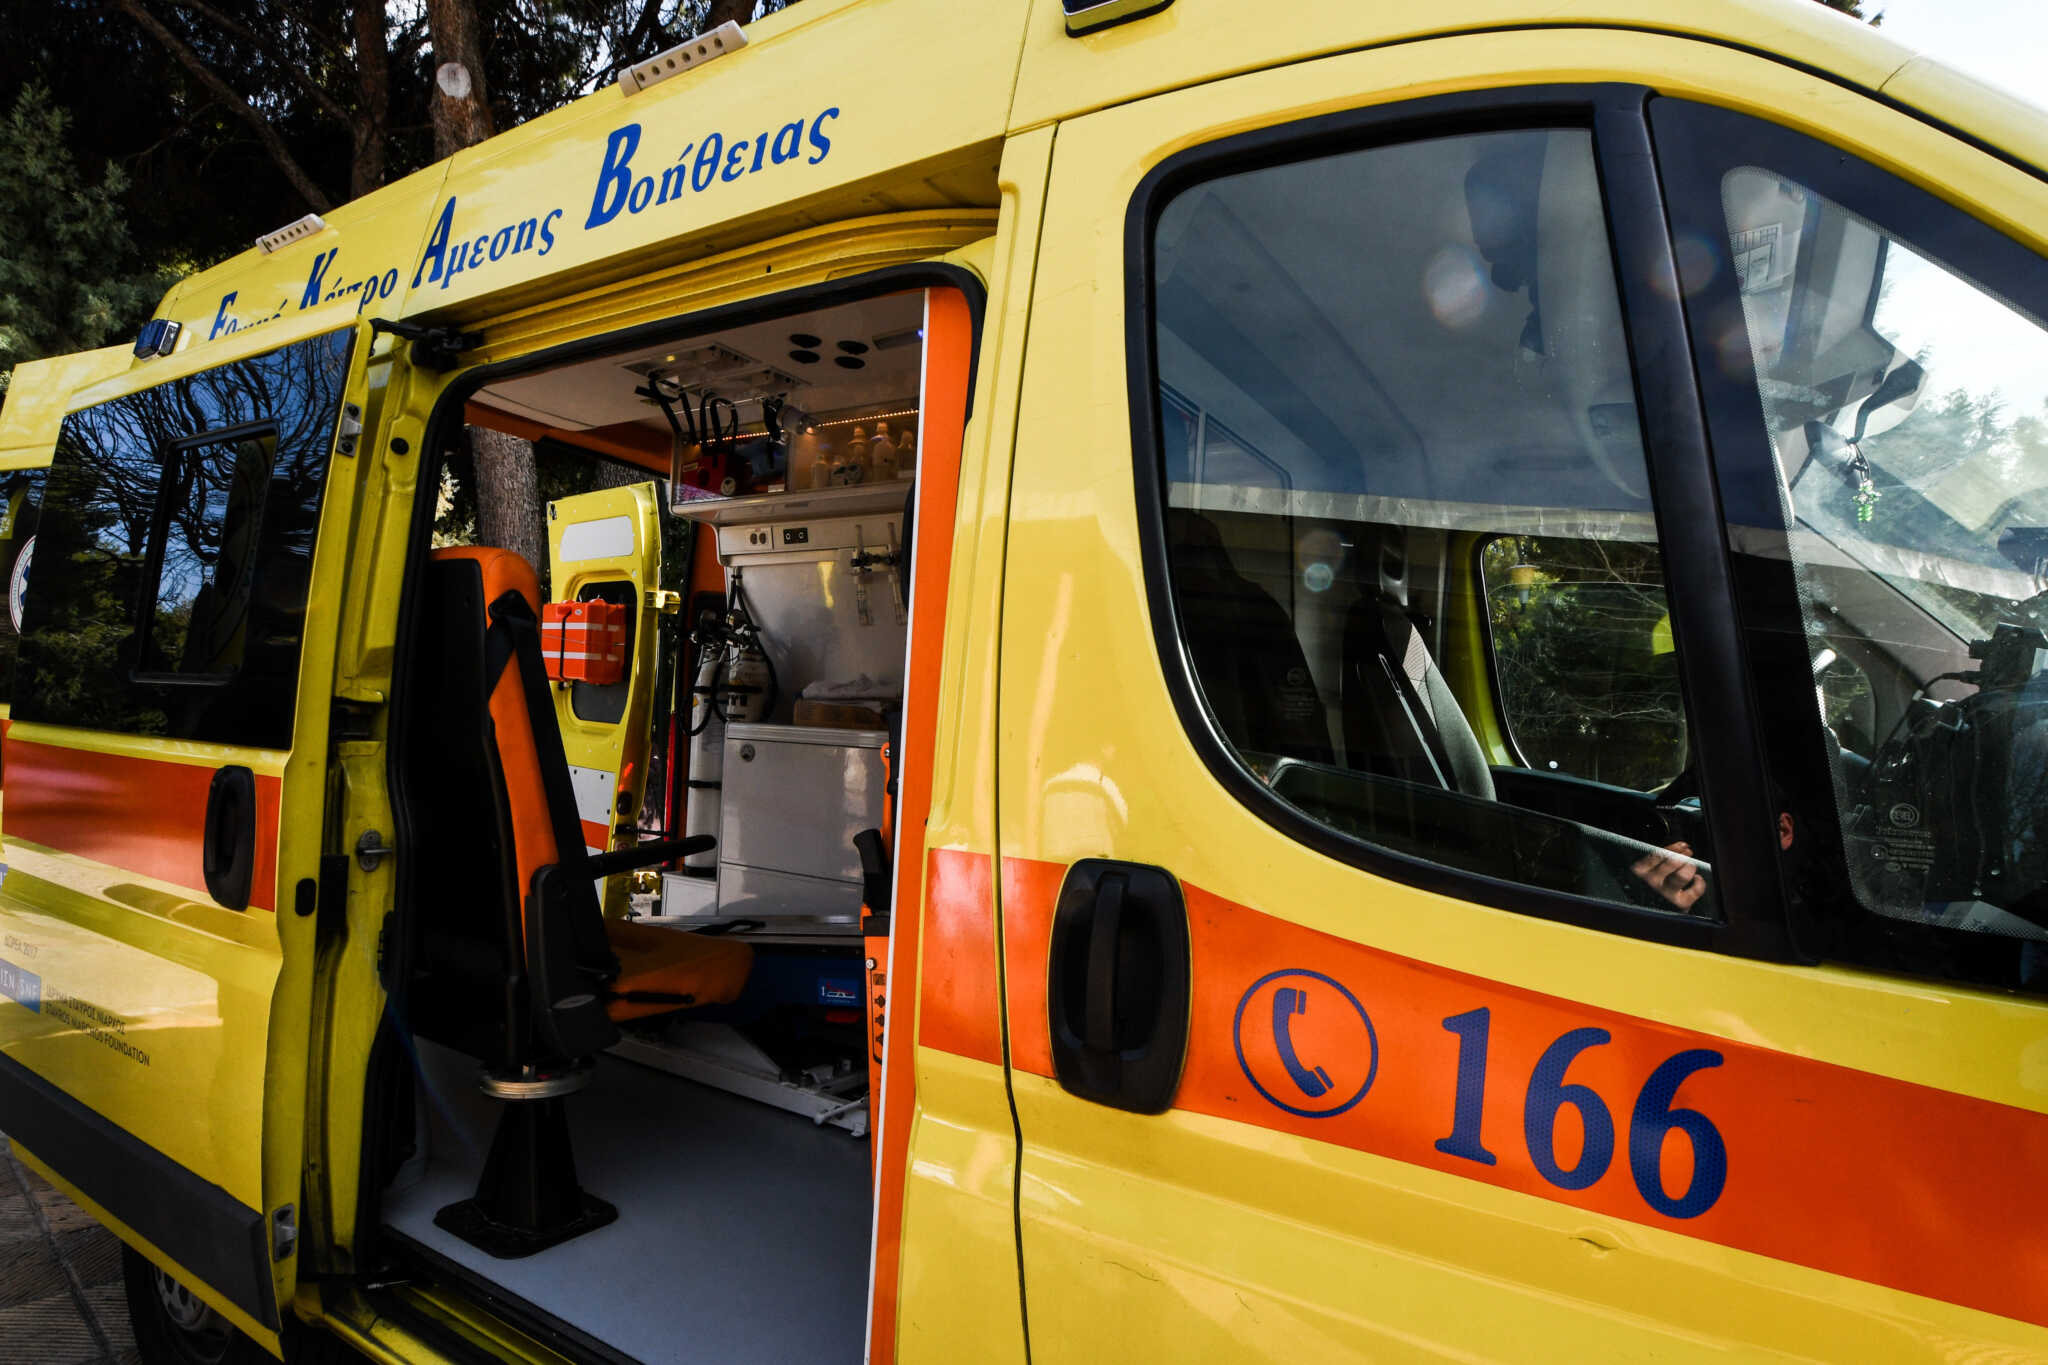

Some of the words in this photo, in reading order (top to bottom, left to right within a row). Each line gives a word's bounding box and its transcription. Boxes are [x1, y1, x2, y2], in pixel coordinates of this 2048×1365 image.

[300, 246, 399, 316] Κρο
[411, 196, 563, 290] Αμεσης
[584, 107, 841, 230] Βοήθειας
[104, 1033, 150, 1066] FOUNDATION
[1434, 1006, 1728, 1219] 166
